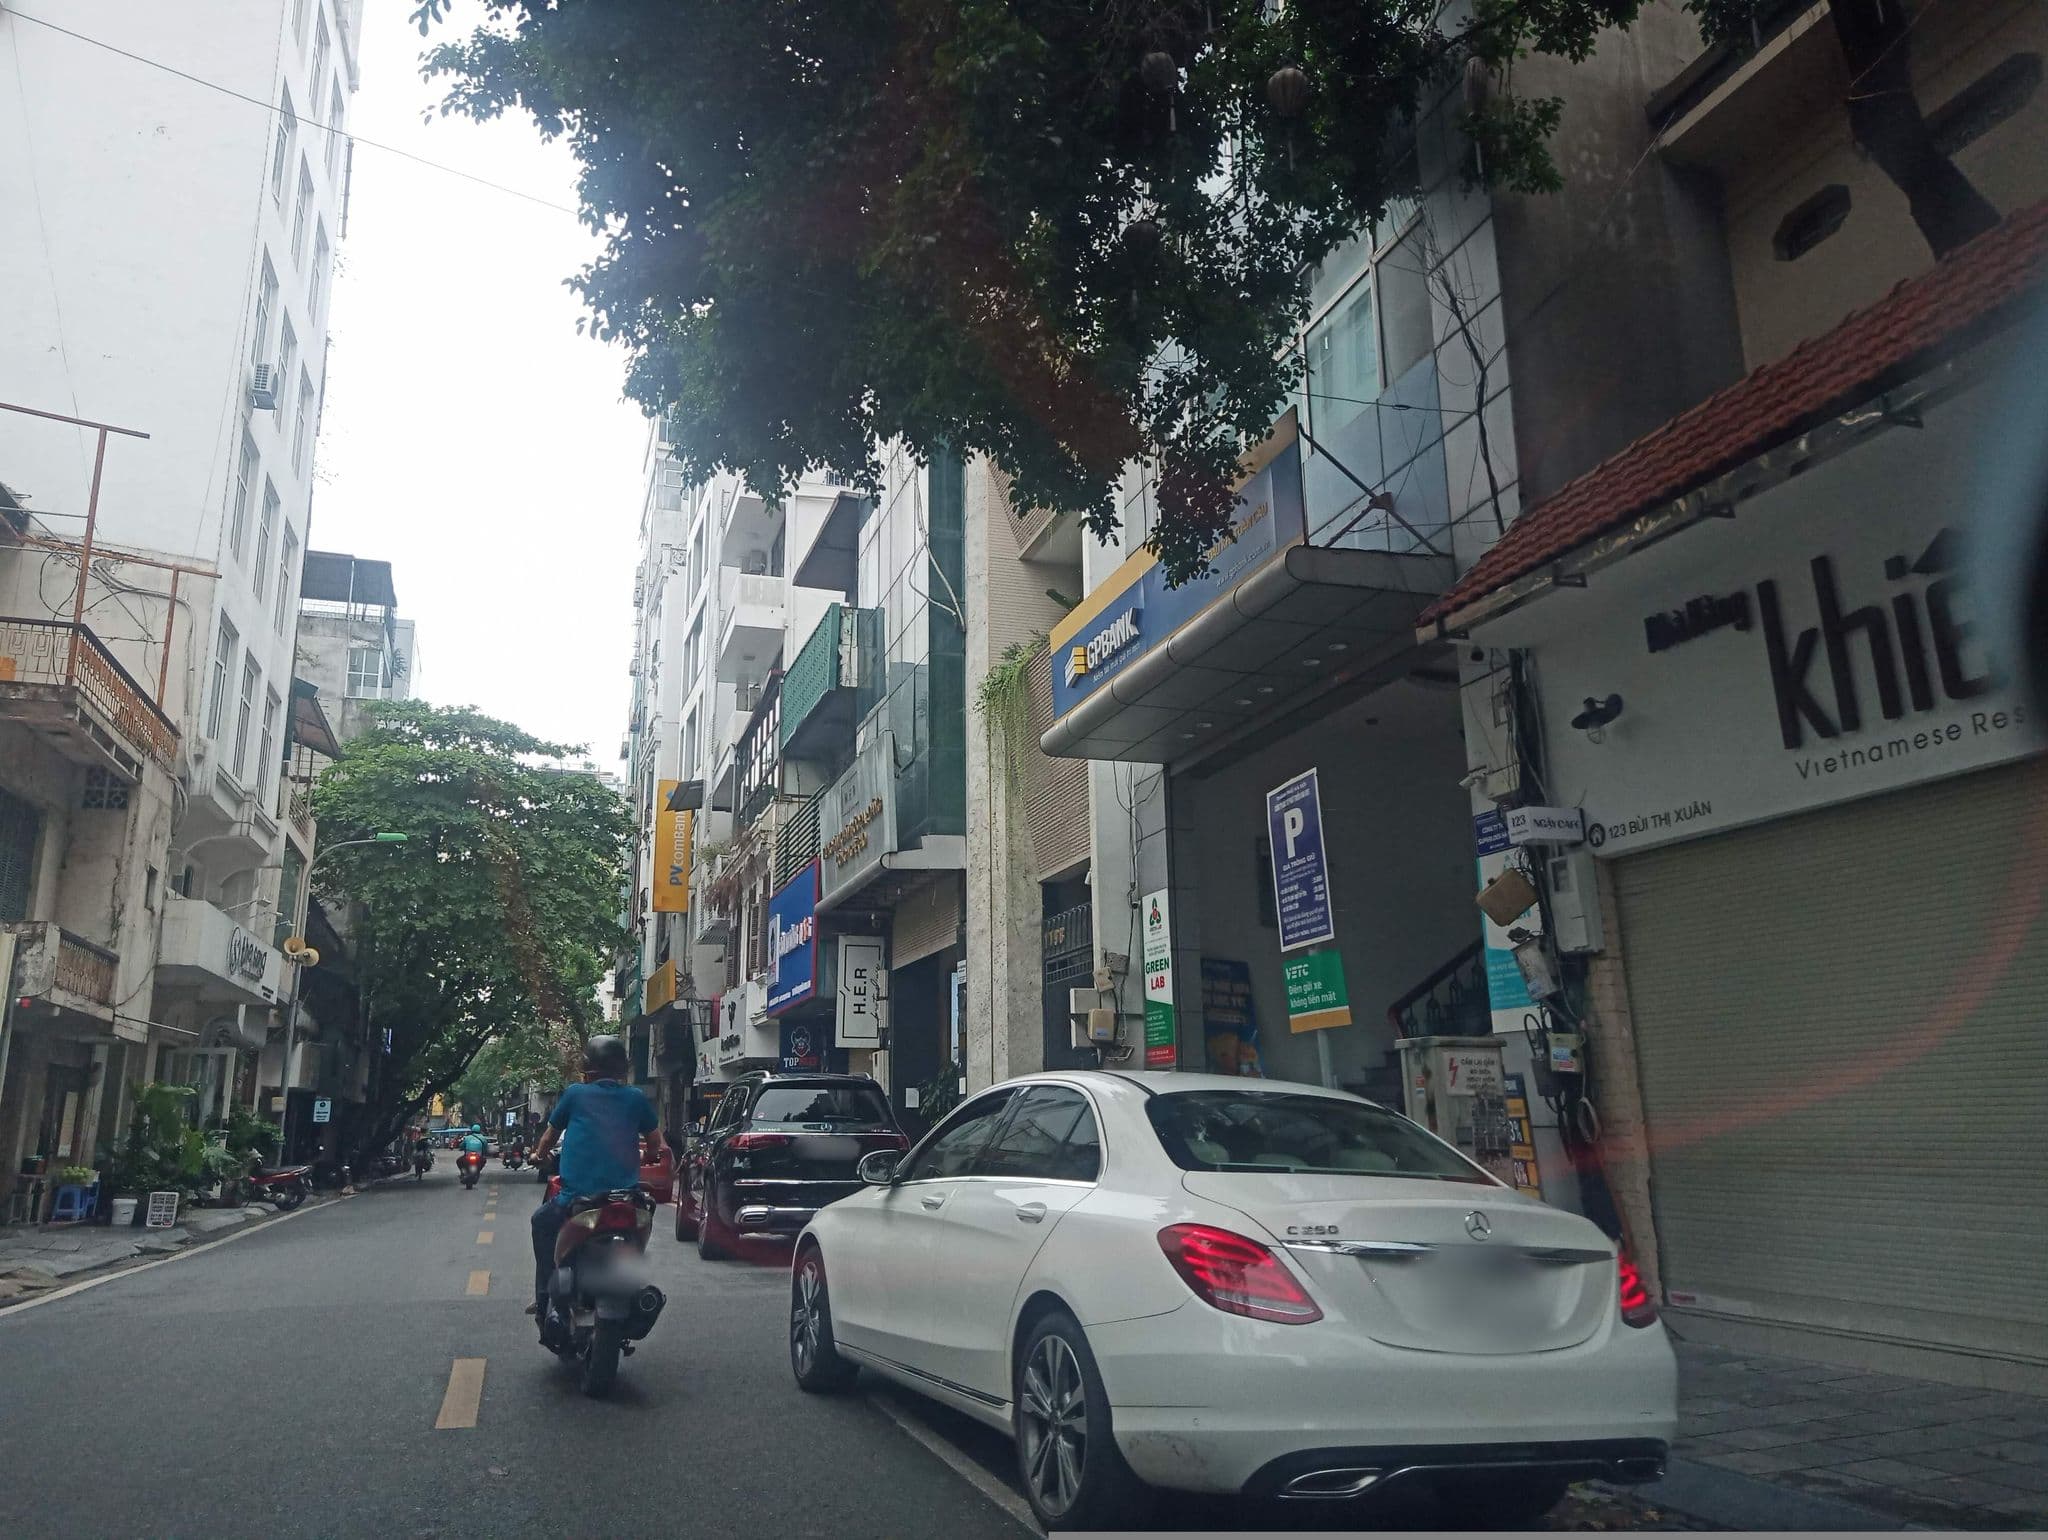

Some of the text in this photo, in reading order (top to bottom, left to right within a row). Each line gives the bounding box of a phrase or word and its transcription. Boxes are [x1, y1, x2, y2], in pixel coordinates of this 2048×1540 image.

[1087, 607, 1140, 669] GPBANK
[1795, 722, 1962, 780] Vietnamese
[1512, 814, 1527, 828] 123
[1609, 800, 1712, 839] 123 BÙI THỊ XUÂN
[1284, 807, 1304, 860] P
[1145, 957, 1169, 975] GREEN
[1286, 964, 1309, 980] VETC
[853, 968, 867, 1015] H.E.R
[1151, 976, 1165, 990] LAB
[1321, 991, 1337, 1004] mặt
[783, 1057, 800, 1068] TOP
[1286, 1225, 1339, 1235] C 250
